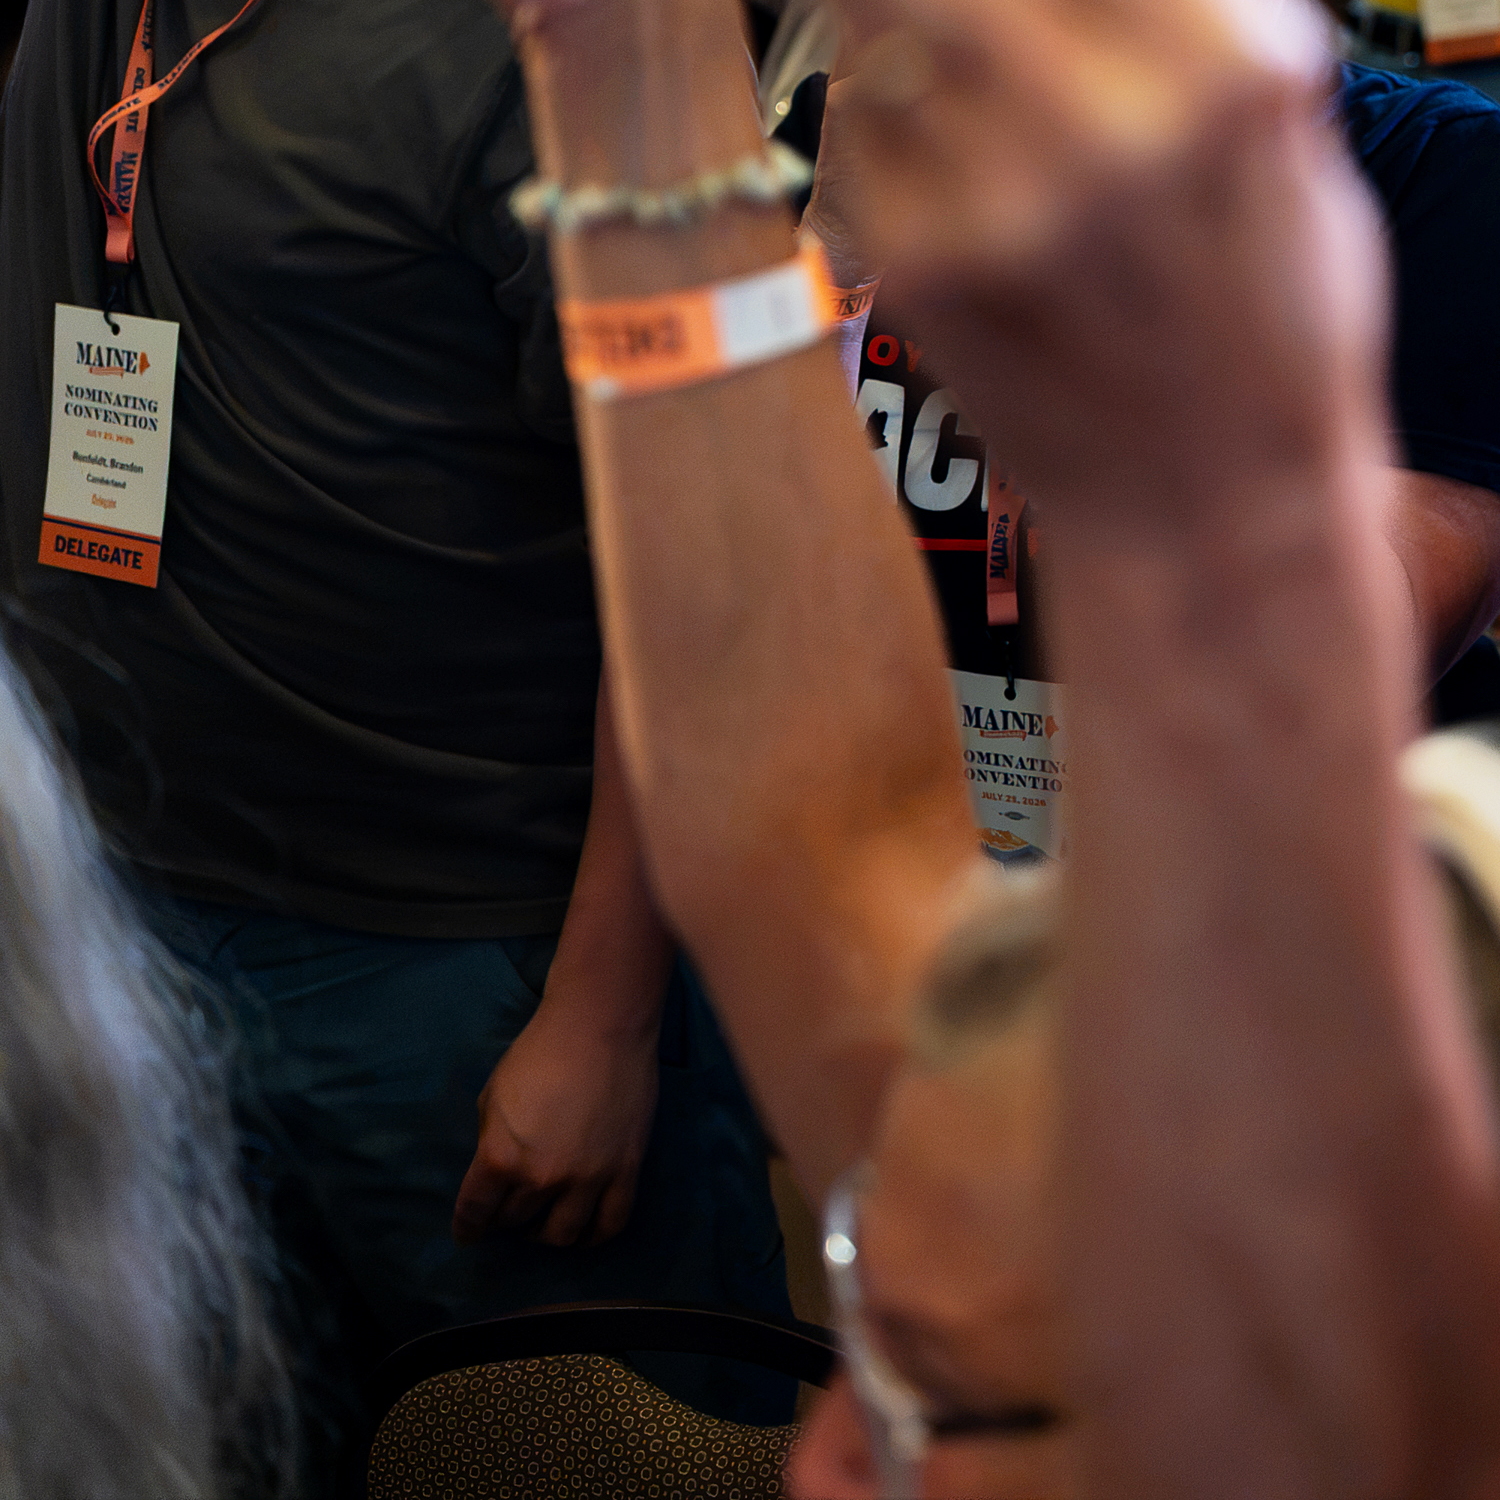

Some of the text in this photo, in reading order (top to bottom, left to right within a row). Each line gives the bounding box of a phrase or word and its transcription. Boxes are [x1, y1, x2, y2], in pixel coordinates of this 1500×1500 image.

[125, 67, 146, 133] DELTE
[76, 341, 138, 375] MAINE
[866, 334, 925, 373] OY
[65, 383, 158, 414] NOMINATING
[64, 402, 159, 432] CONVENTION
[54, 534, 144, 570] DELEGATE
[962, 704, 1044, 737] MAINE
[963, 749, 1066, 775] OMINATIN
[964, 767, 1063, 793] ONVENTIO
[981, 791, 1003, 802] JULY
